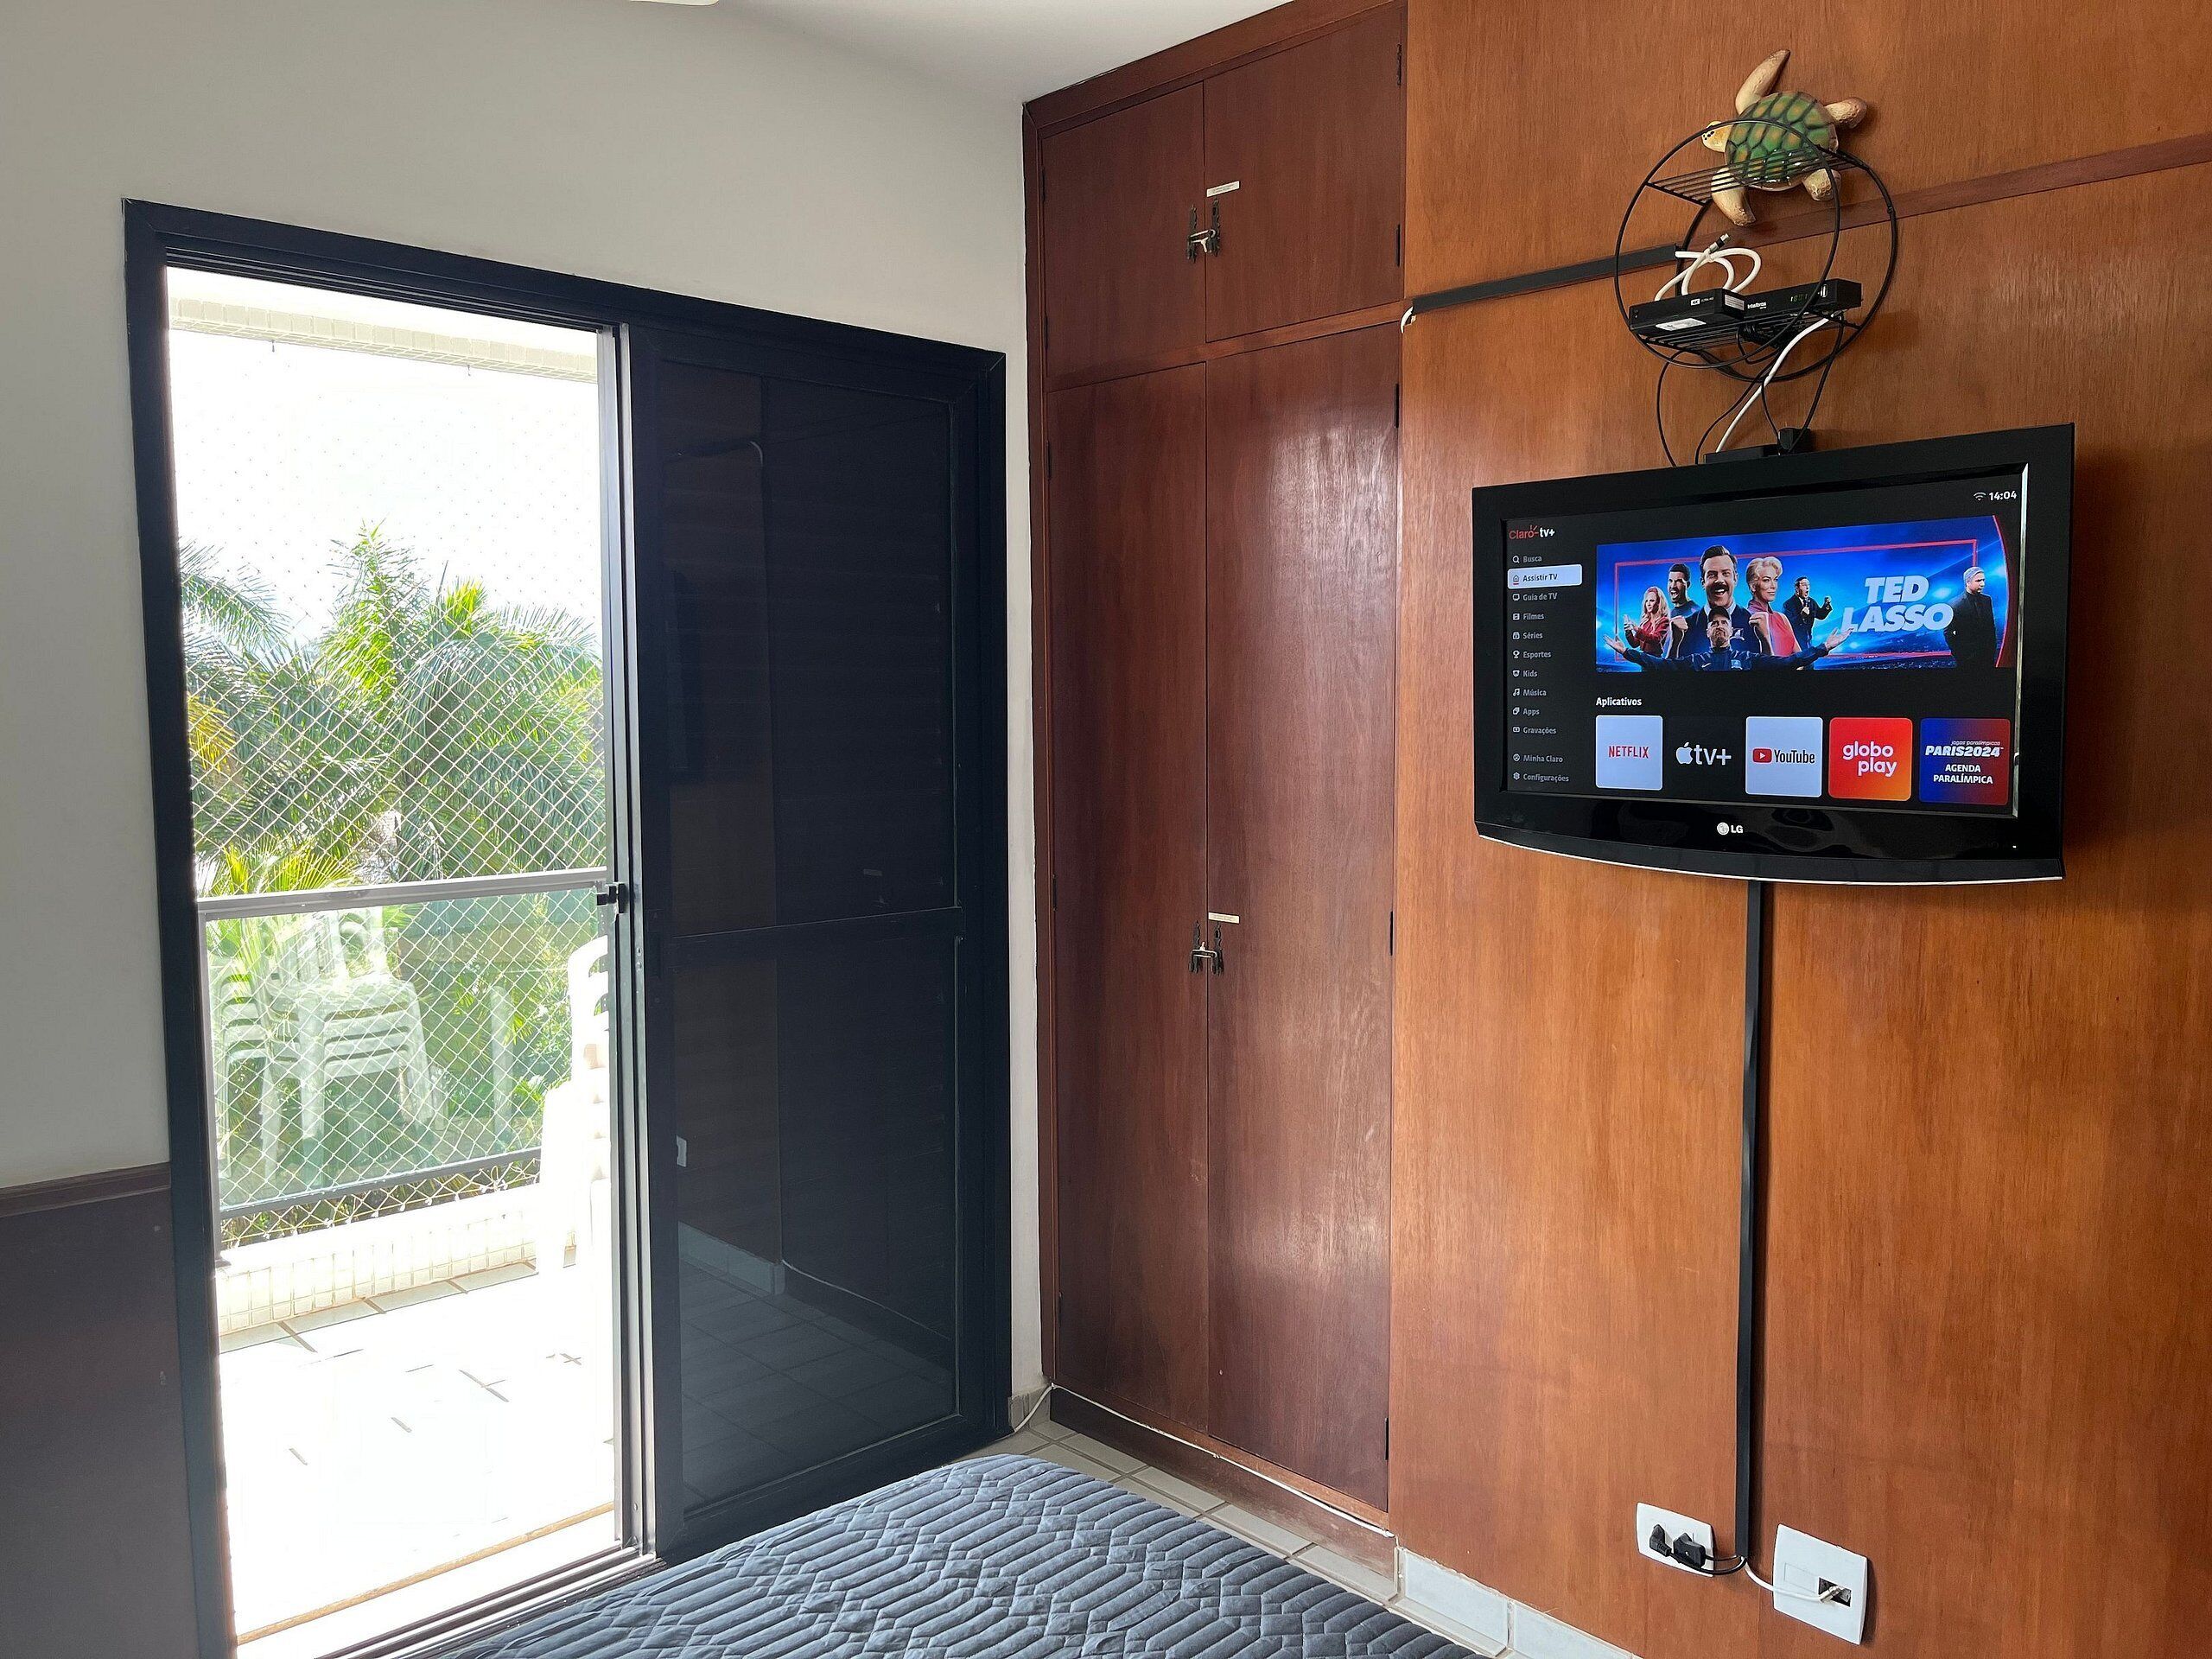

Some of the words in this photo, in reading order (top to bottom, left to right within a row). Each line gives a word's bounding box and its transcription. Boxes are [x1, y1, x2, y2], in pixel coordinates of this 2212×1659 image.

[1989, 491, 2017, 500] 14:04
[1509, 529, 1535, 539] Claro
[1540, 527, 1554, 537] tv+
[1865, 575, 1929, 604] TED
[1840, 603, 1954, 632] LASSO
[1522, 651, 1552, 659] Esportes
[1596, 697, 1642, 708] Aplicativos
[1522, 708, 1540, 716] Apps
[1522, 727, 1556, 735] Gravações
[1609, 746, 1649, 759] NETFLIX
[1694, 744, 1732, 766] tv+
[1842, 741, 1894, 760] globo
[1925, 746, 2000, 757] PARIS2024
[1774, 750, 1815, 764] YouTube
[1858, 756, 1897, 778] play
[1945, 764, 1981, 772] AGENDA
[1522, 773, 1569, 783] Configurações
[1933, 774, 1993, 784] PARALÍMPICA
[1731, 824, 1744, 834] LG
